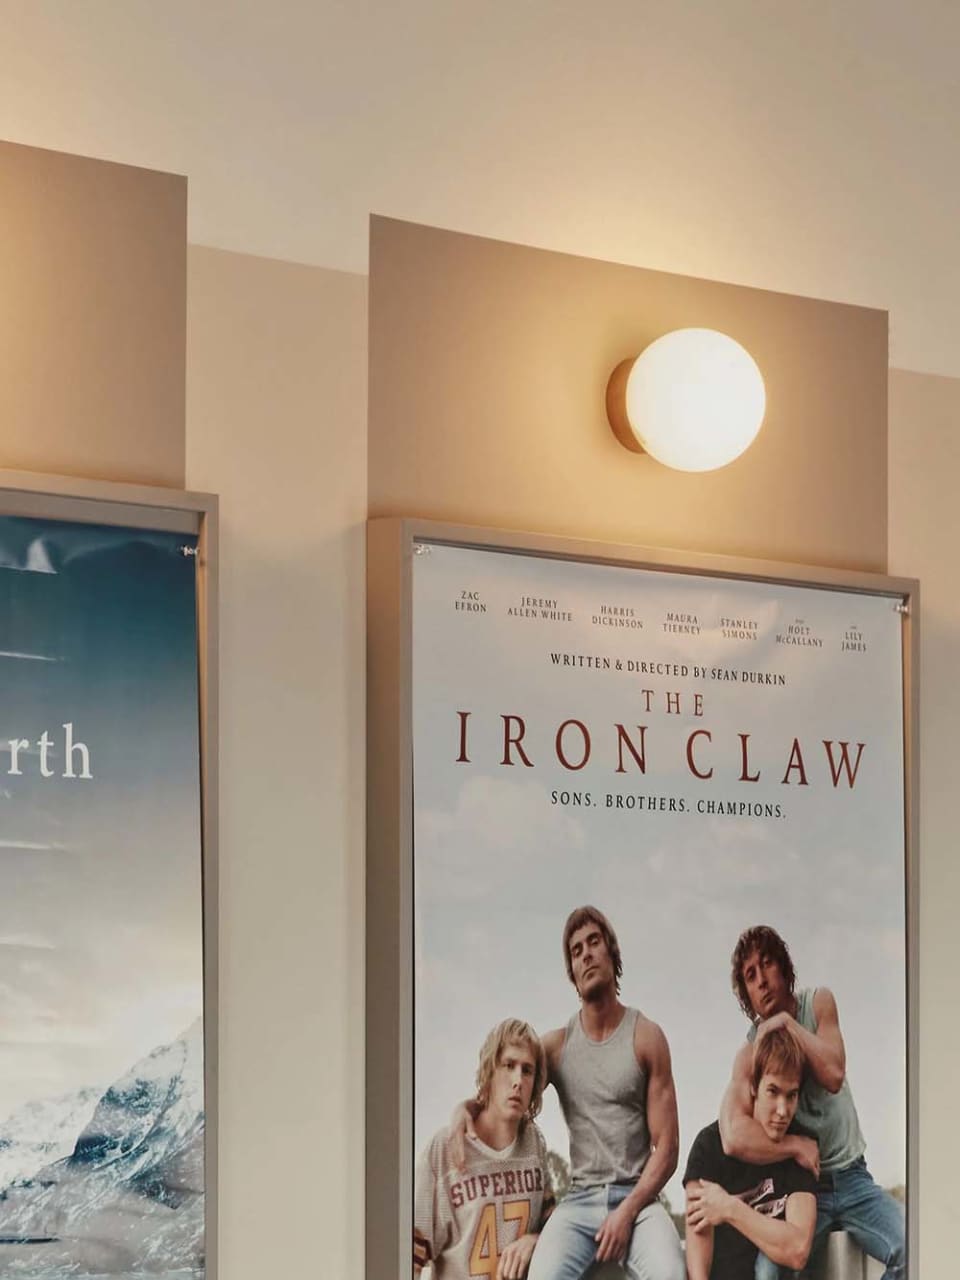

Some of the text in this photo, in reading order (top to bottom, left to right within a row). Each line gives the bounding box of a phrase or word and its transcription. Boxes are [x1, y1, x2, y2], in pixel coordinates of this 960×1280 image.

[461, 591, 480, 600] ZAC
[455, 601, 487, 612] EFRON
[521, 597, 558, 609] JEREMY
[507, 607, 573, 622] ALLEN WHITE
[601, 605, 634, 617] HARRIS
[592, 616, 643, 629] DICKINSON
[666, 613, 698, 624] MAURA
[720, 618, 758, 630] STANLEY
[663, 623, 701, 635] TIERNEY
[722, 630, 757, 641] SIMONS
[550, 653, 786, 686] WRITTEN & DIRECTED BY SEAN DURKIN
[641, 689, 705, 717] THE
[455, 711, 866, 789] IRON CLAW
[551, 790, 786, 819] SONS. BROTHERS. CHAMPIONS.
[451, 1167, 543, 1208] SUPERIOR
